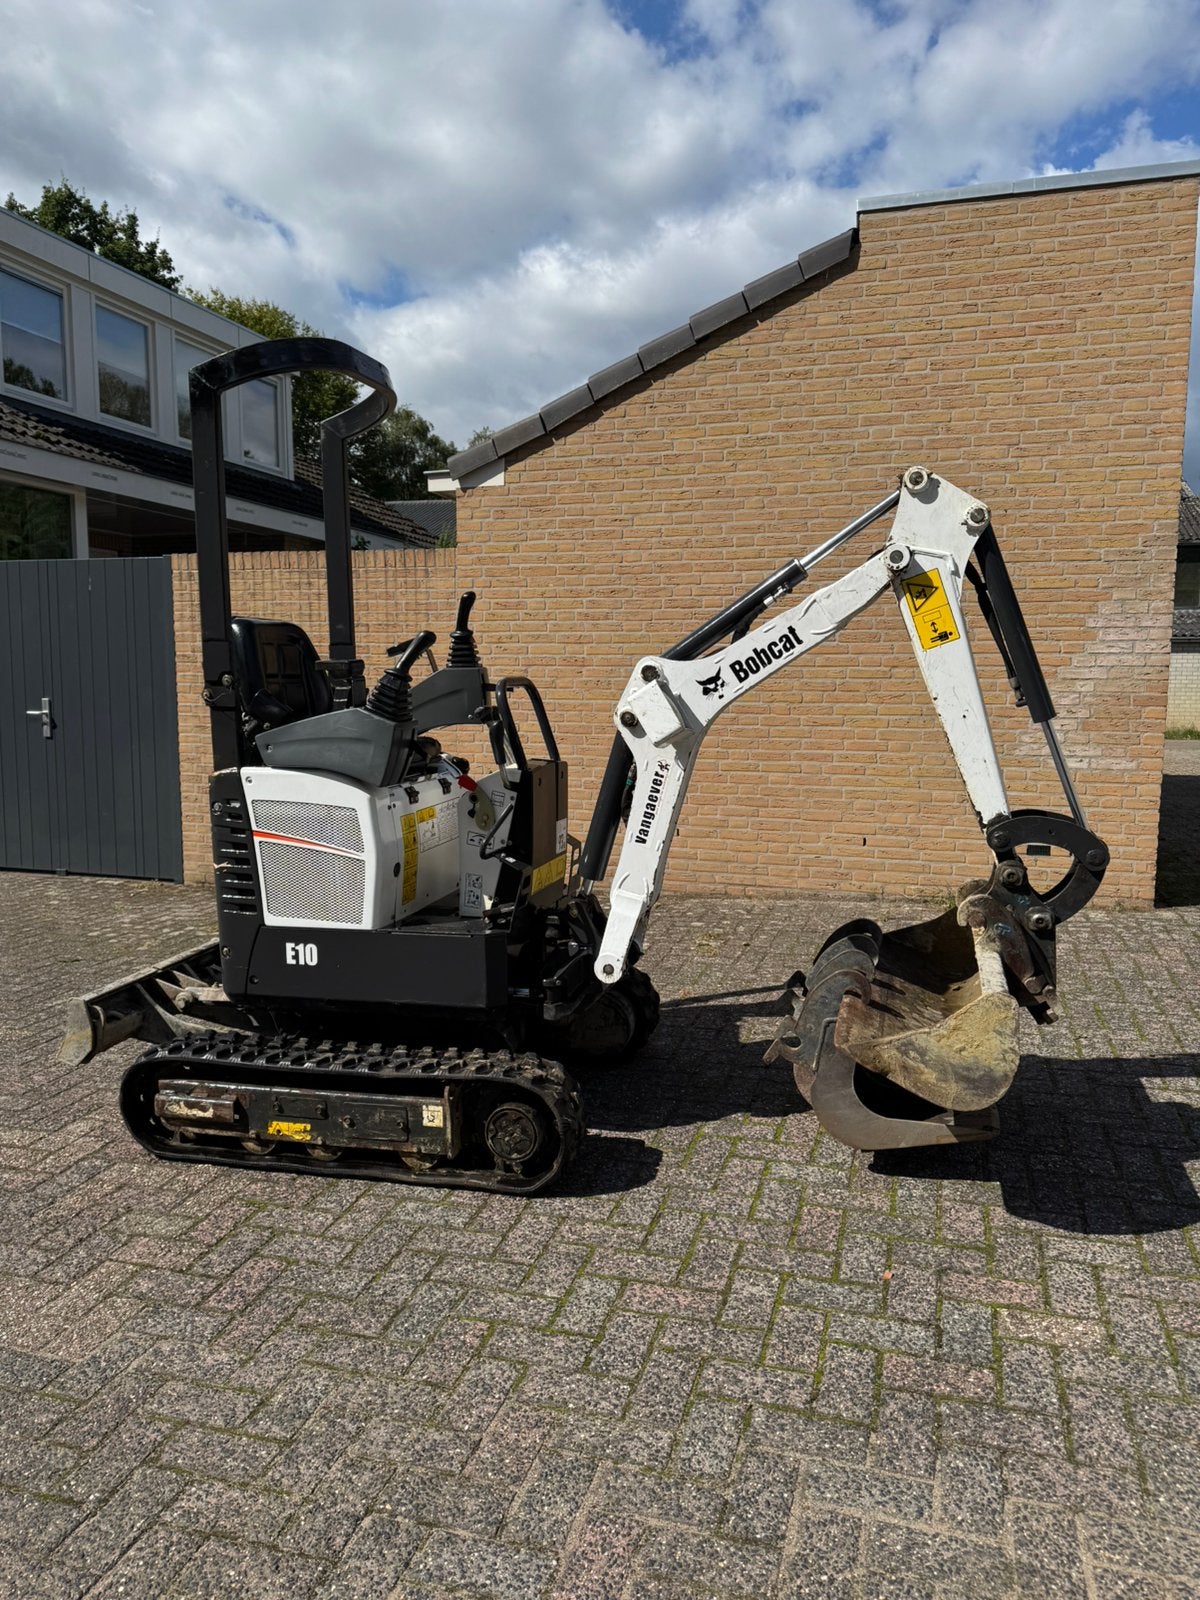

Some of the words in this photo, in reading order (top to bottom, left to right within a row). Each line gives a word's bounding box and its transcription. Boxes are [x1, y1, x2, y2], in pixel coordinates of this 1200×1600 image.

[729, 625, 803, 684] Bobcat
[635, 771, 665, 844] Vangaever
[285, 942, 318, 966] E10
